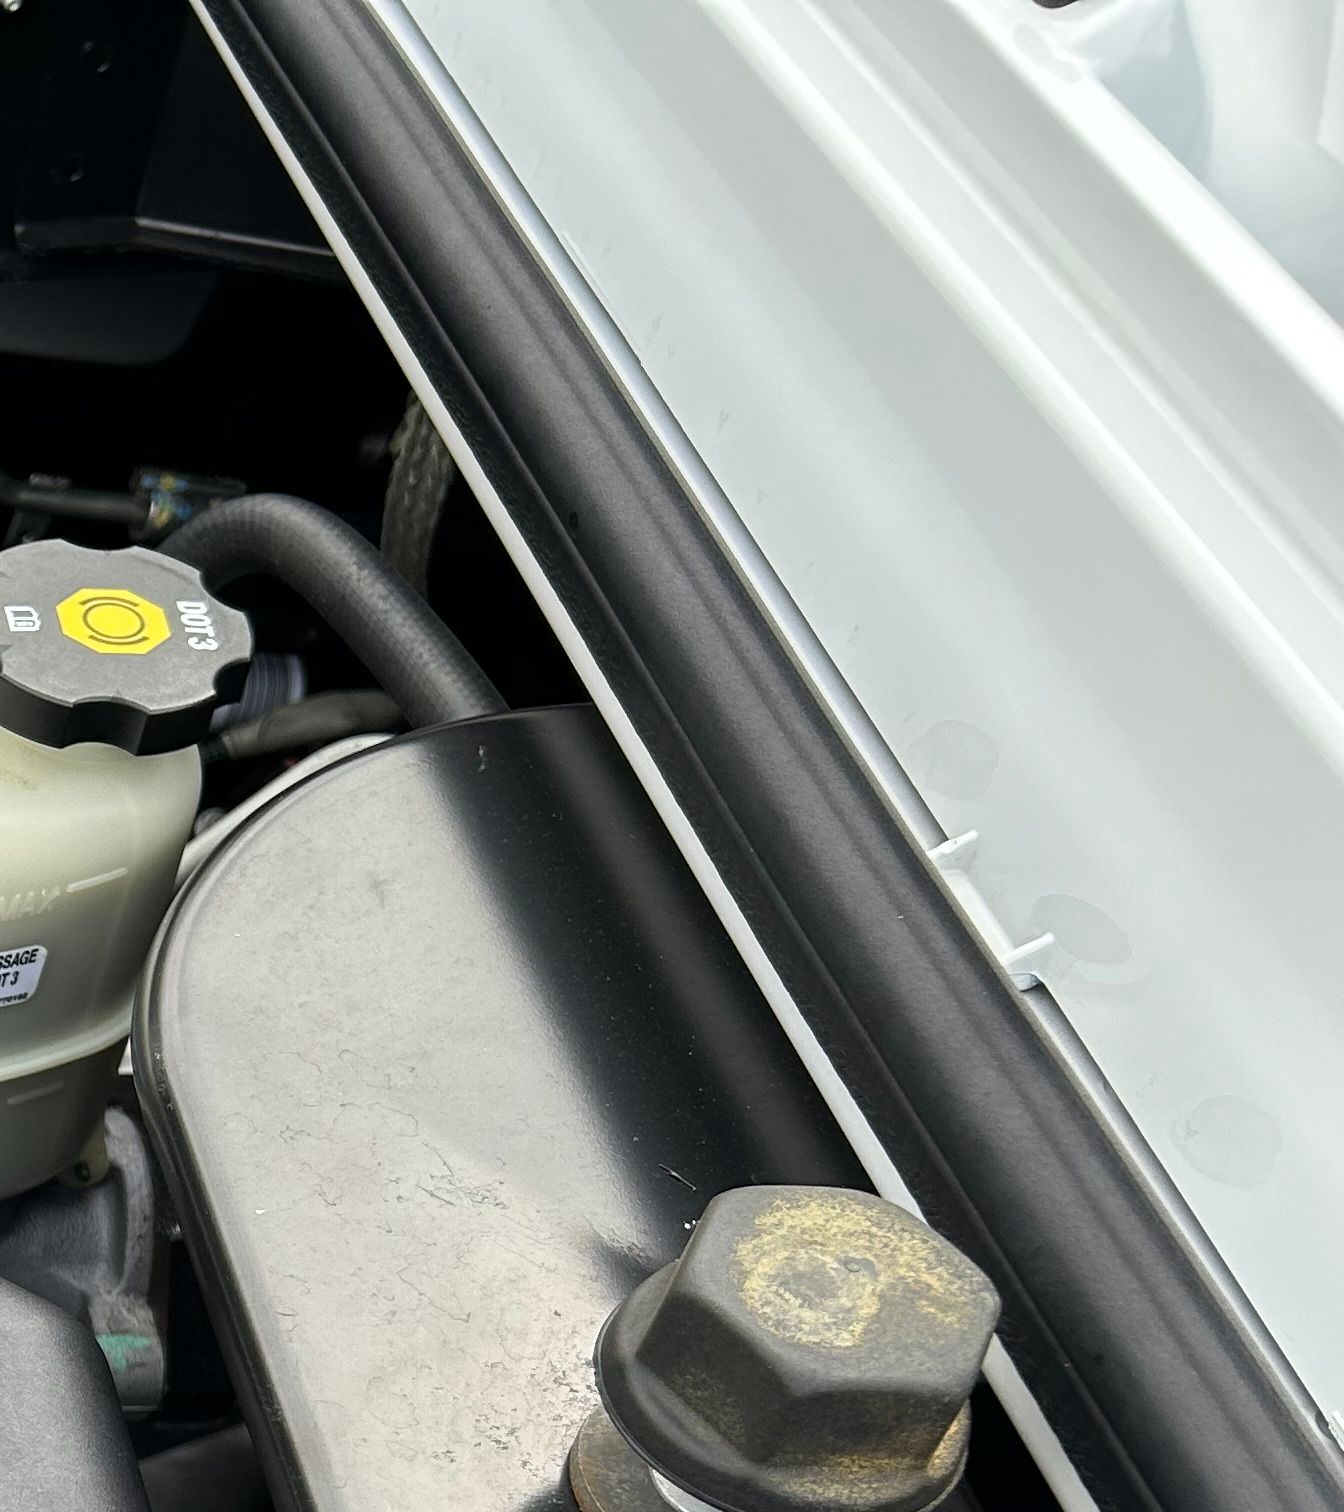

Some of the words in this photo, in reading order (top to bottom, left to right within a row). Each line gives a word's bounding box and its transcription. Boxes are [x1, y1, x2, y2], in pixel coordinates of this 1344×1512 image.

[175, 600, 215, 638] DOT
[187, 636, 219, 651] 3
[10, 970, 20, 986] 3
